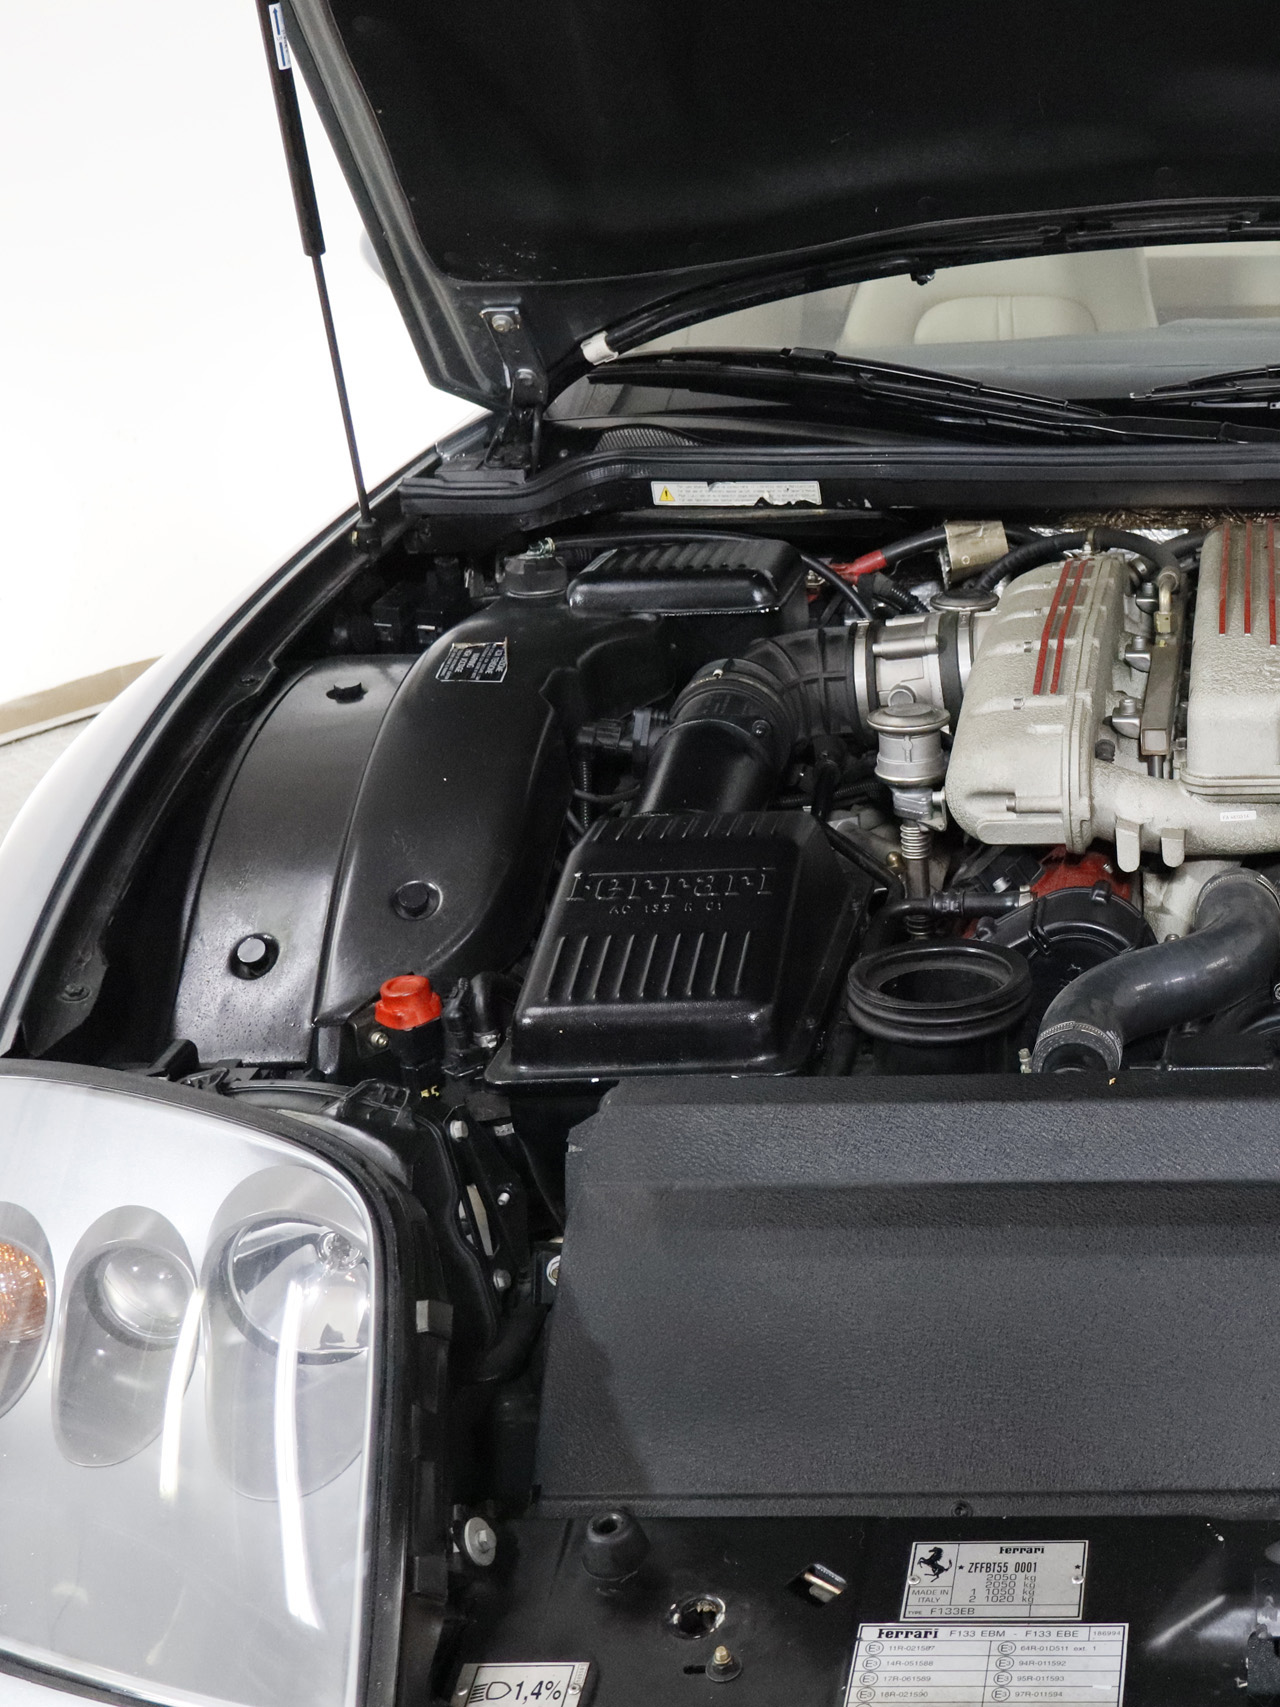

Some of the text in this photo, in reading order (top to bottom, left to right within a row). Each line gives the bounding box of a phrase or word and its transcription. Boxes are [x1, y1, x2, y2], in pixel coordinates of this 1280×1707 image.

[999, 1546, 1044, 1554] Ferrari
[968, 1562, 1037, 1573] ZFFBT55 0001
[1024, 1574, 1036, 1582] kg
[1023, 1581, 1036, 1590] kg
[1022, 1588, 1035, 1597] kg
[985, 1595, 1014, 1603] 1020
[1022, 1596, 1034, 1605] kg
[930, 1607, 975, 1615] F133EB
[877, 1628, 939, 1639] Ferrari
[1056, 1630, 1079, 1638] EBE
[515, 1680, 561, 1704] 1,4%
